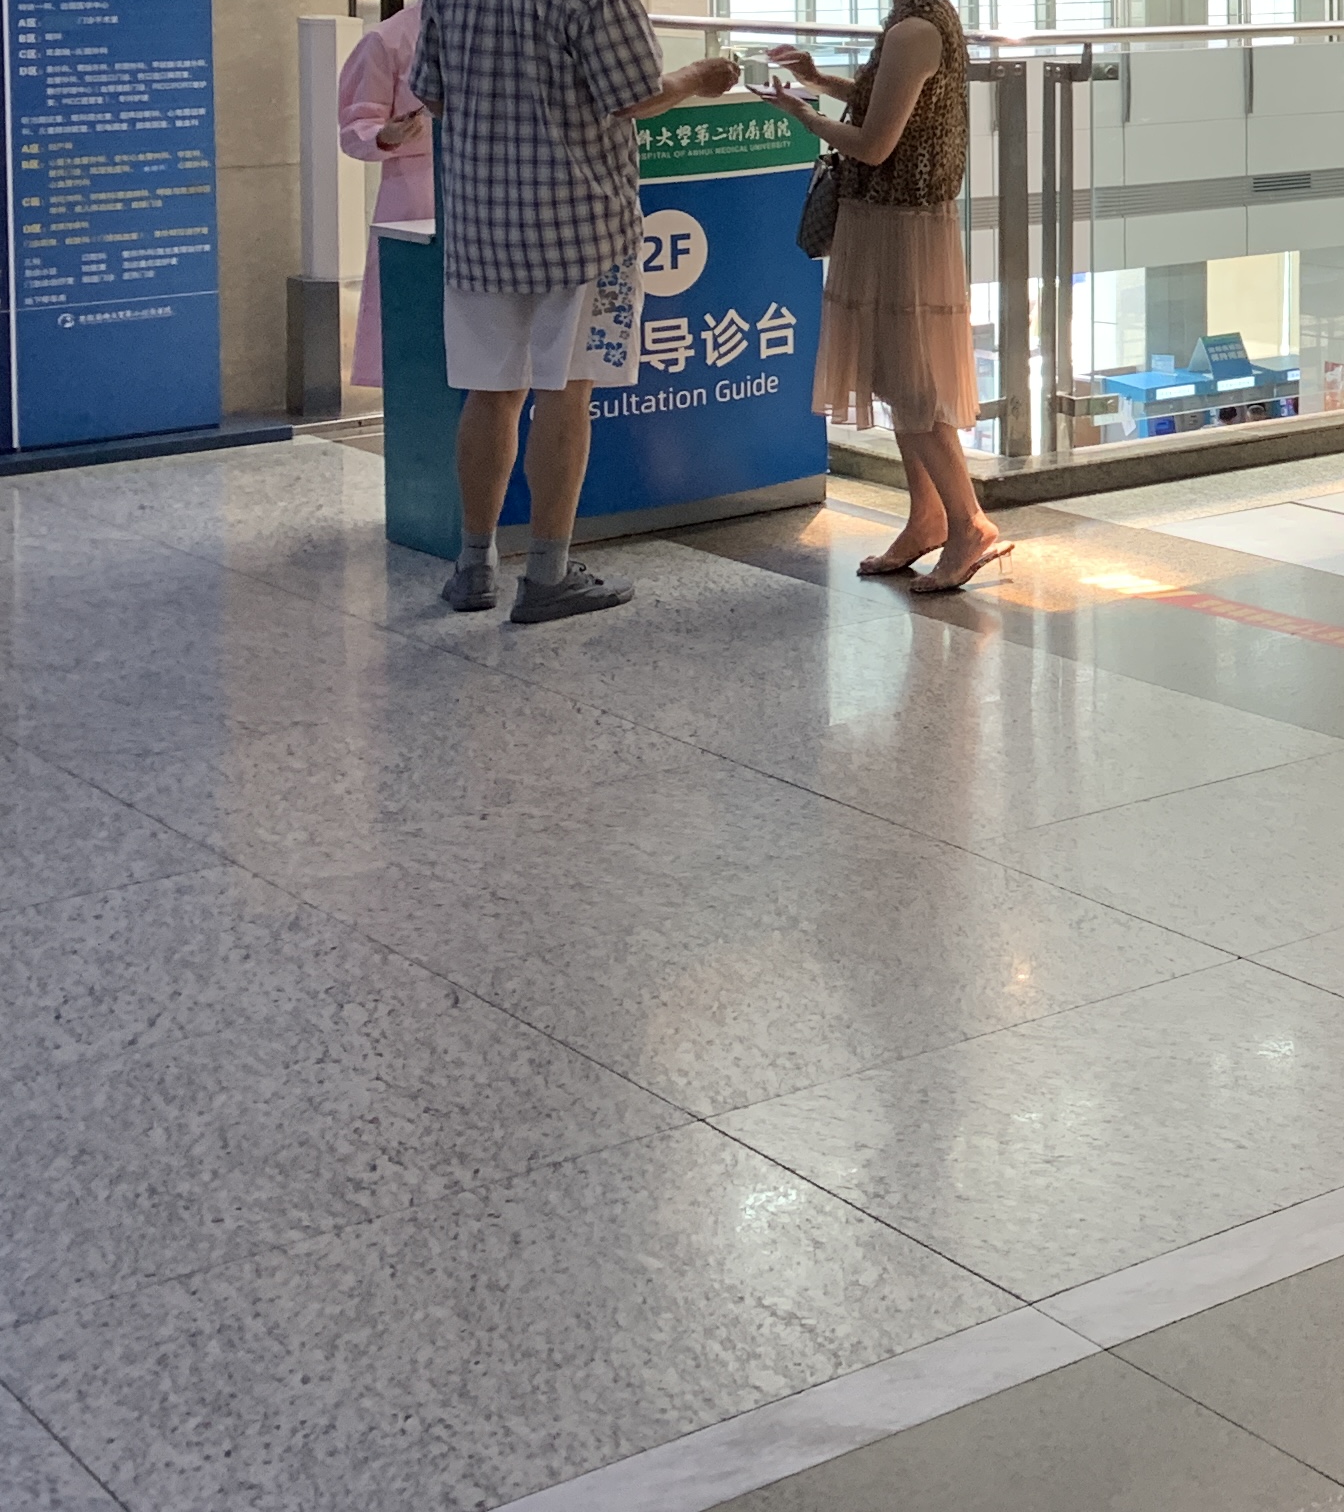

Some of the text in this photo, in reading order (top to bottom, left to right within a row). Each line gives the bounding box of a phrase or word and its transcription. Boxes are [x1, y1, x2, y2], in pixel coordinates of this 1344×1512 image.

[643, 232, 692, 273] 2F
[640, 301, 797, 373] 导诊台
[714, 371, 780, 403] Guide
